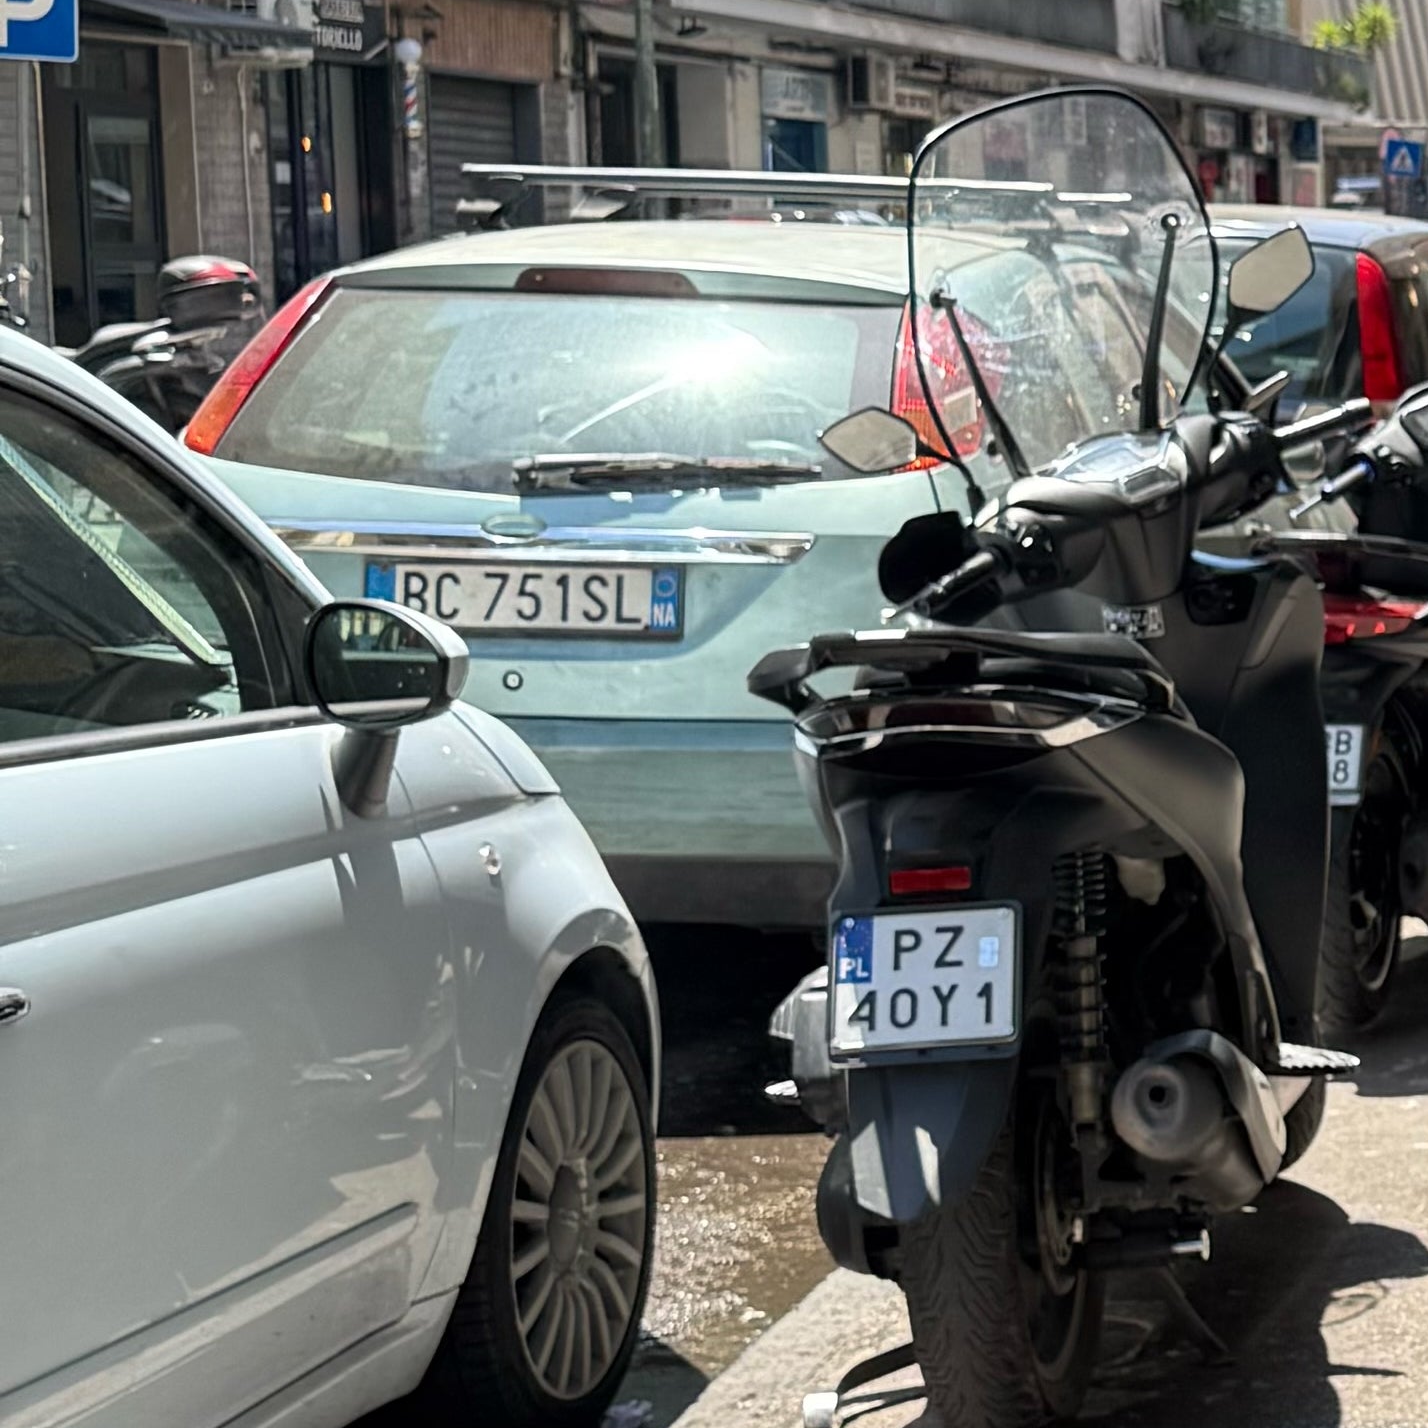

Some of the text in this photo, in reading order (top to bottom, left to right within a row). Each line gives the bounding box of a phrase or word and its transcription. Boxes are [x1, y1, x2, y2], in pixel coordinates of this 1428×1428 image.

[403, 570, 642, 624] BC 751SL
[653, 602, 676, 627] NA
[1326, 729, 1353, 756] B
[892, 924, 965, 972] PZ
[838, 956, 870, 980] PL
[847, 981, 994, 1032] 40Y1
